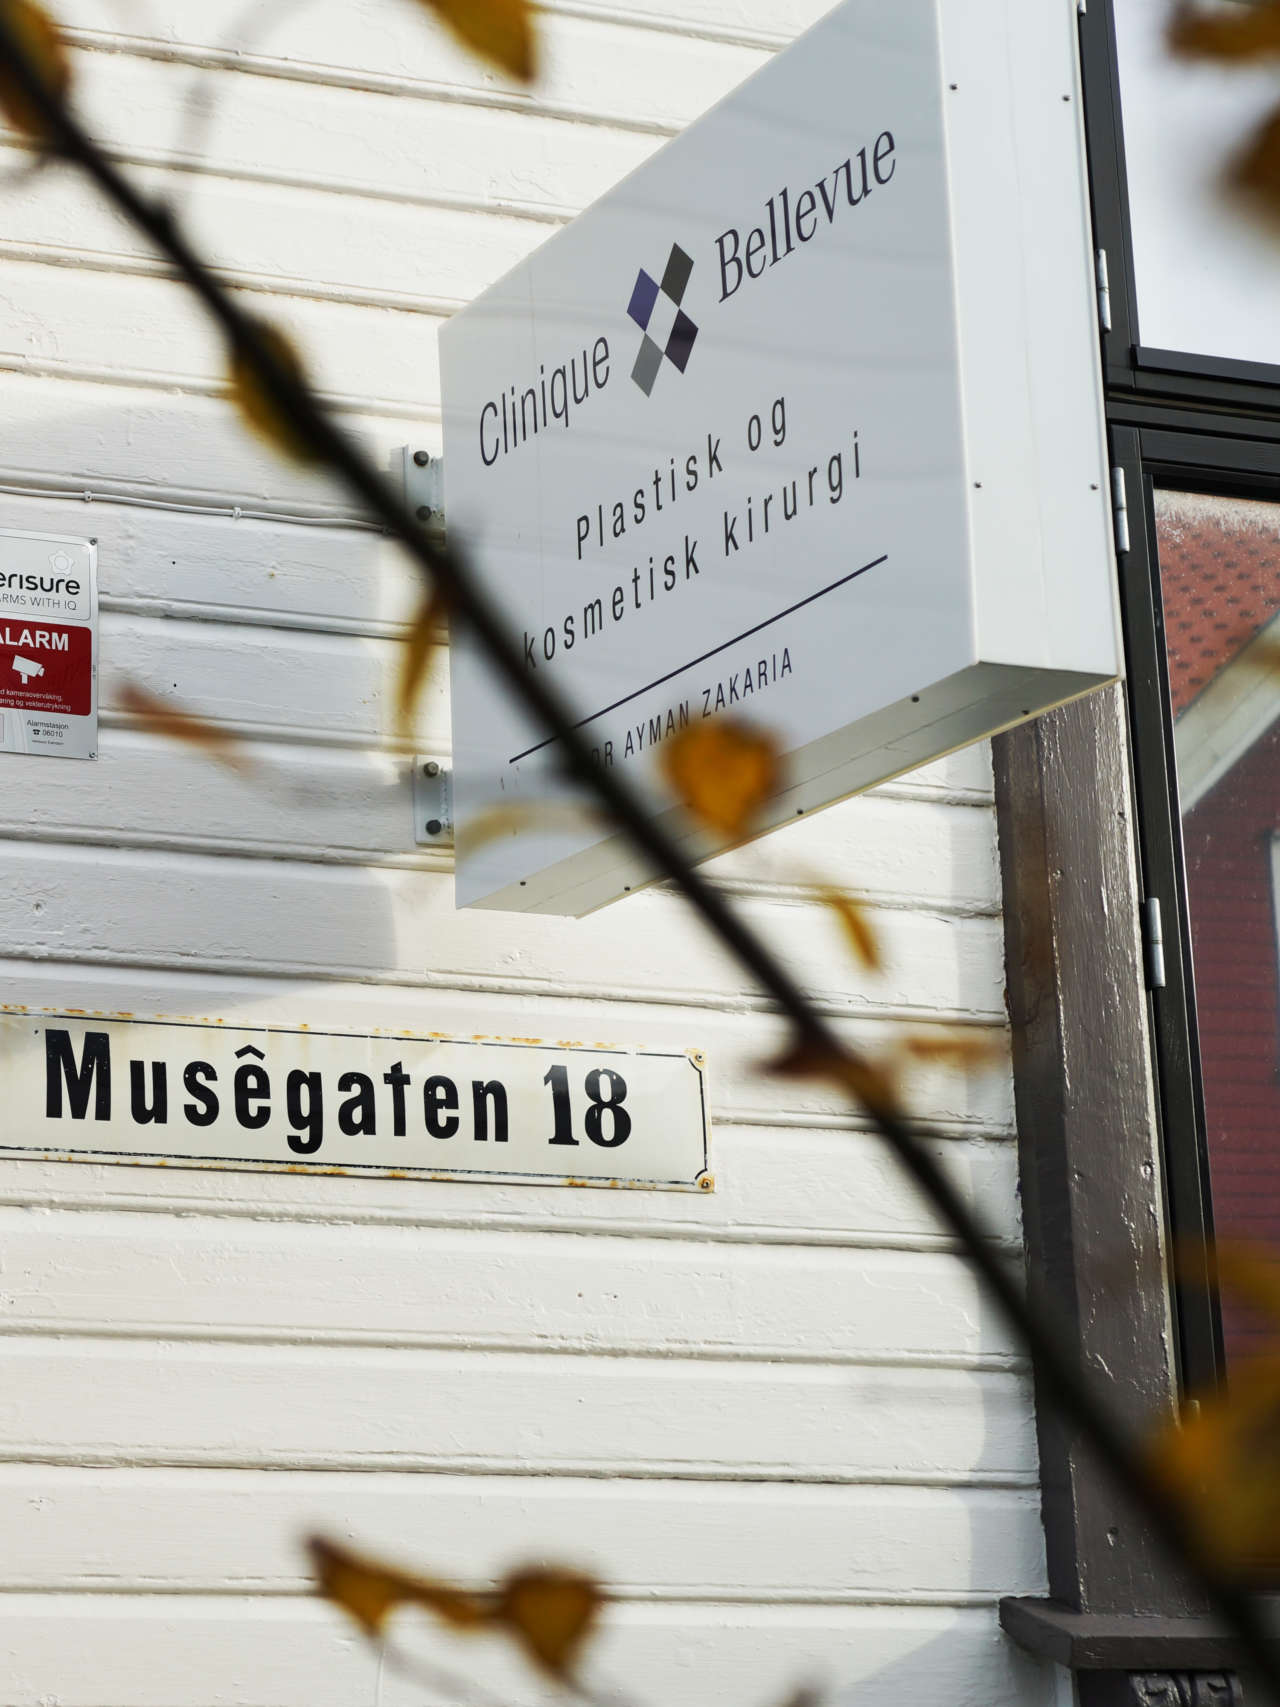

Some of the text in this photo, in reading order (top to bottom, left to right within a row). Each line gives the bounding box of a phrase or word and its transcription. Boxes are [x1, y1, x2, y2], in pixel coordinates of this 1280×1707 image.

[479, 130, 896, 467] Clinique Bellevue
[576, 396, 786, 561] Plastisk og
[29, 596, 61, 609] WITH
[64, 600, 78, 611] IQ
[523, 430, 861, 670] kosmetisk kirurgi
[27, 719, 69, 730] Alarmstasjon
[624, 700, 689, 759] AYMAN
[702, 647, 793, 719] ZAKARIA
[44, 1028, 632, 1155] Musêgaten 18
